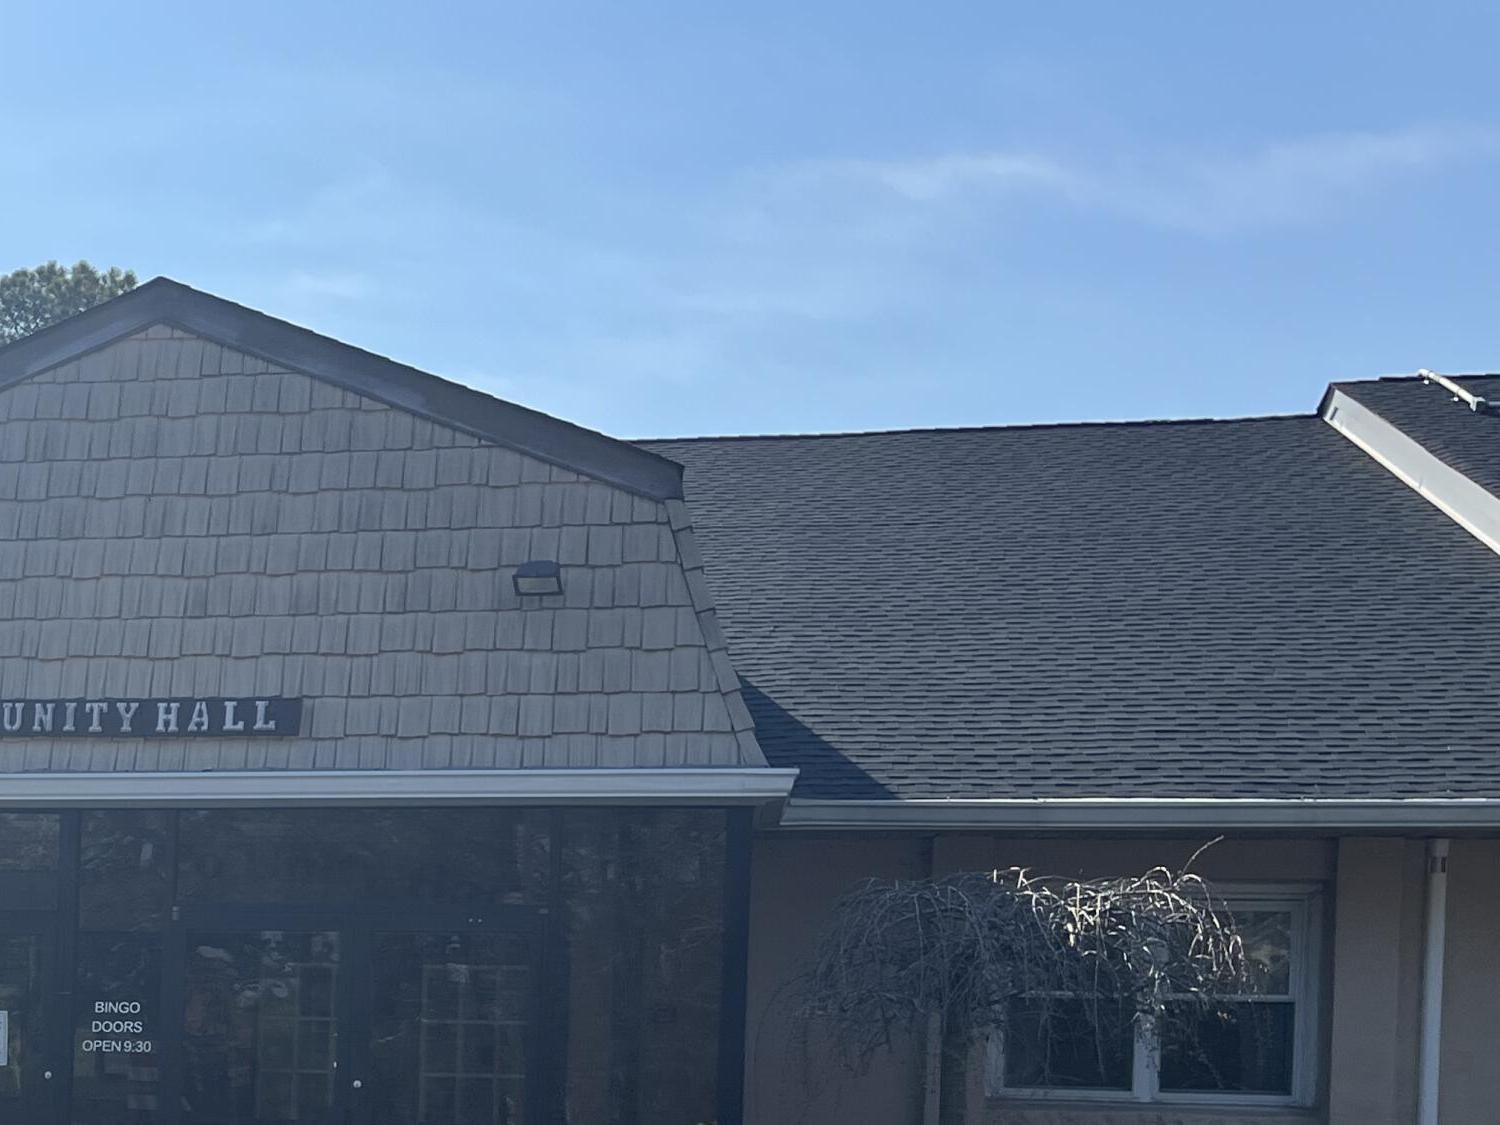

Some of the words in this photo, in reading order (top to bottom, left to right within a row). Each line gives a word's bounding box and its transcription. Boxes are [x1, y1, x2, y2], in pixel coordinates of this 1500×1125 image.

[3, 702, 140, 733] UNITY
[154, 701, 276, 733] HALL
[94, 1001, 141, 1014] BINGO
[91, 1020, 143, 1033] DOORS
[82, 1039, 122, 1052] OPEN
